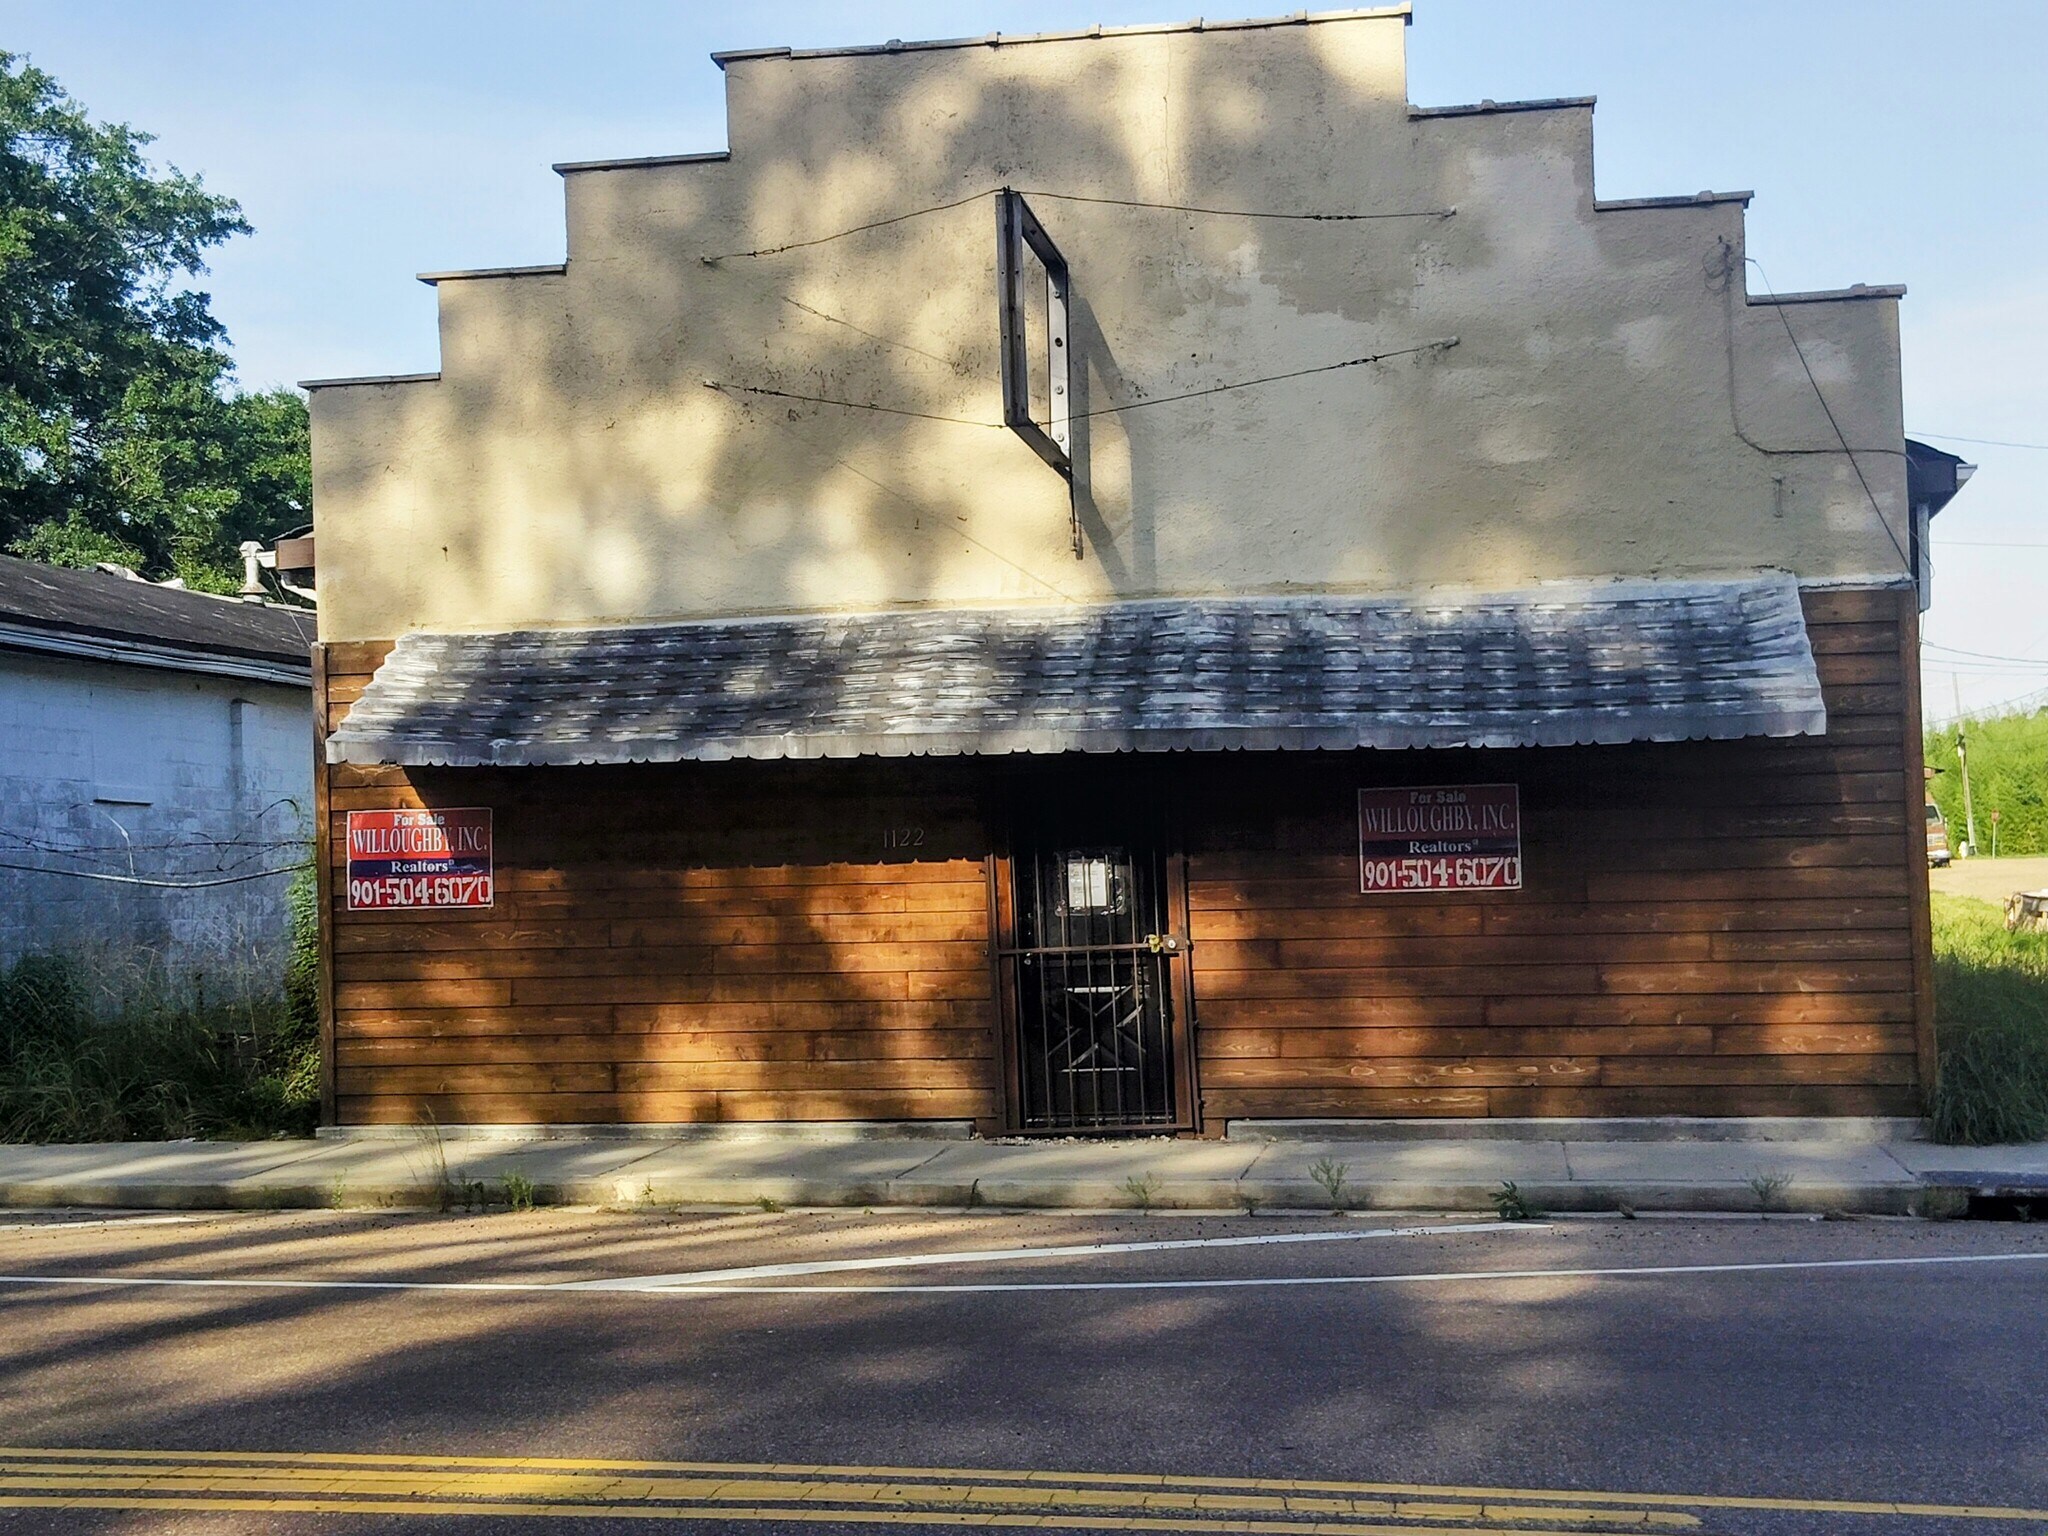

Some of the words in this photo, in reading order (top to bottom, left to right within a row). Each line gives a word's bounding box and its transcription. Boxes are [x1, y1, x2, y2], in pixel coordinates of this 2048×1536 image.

[1410, 792, 1432, 804] For
[1436, 791, 1466, 803] Sale
[394, 813, 414, 827] For
[417, 813, 445, 826] Sale
[1365, 805, 1478, 833] WILLOUGHBY,
[1482, 804, 1514, 830] INC.
[352, 827, 455, 854] WILLOUGHBY,
[458, 826, 487, 850] INC.
[884, 828, 925, 848] 1122
[1365, 857, 1519, 888] 901-504-6070
[351, 876, 491, 906] 901-504-6070
